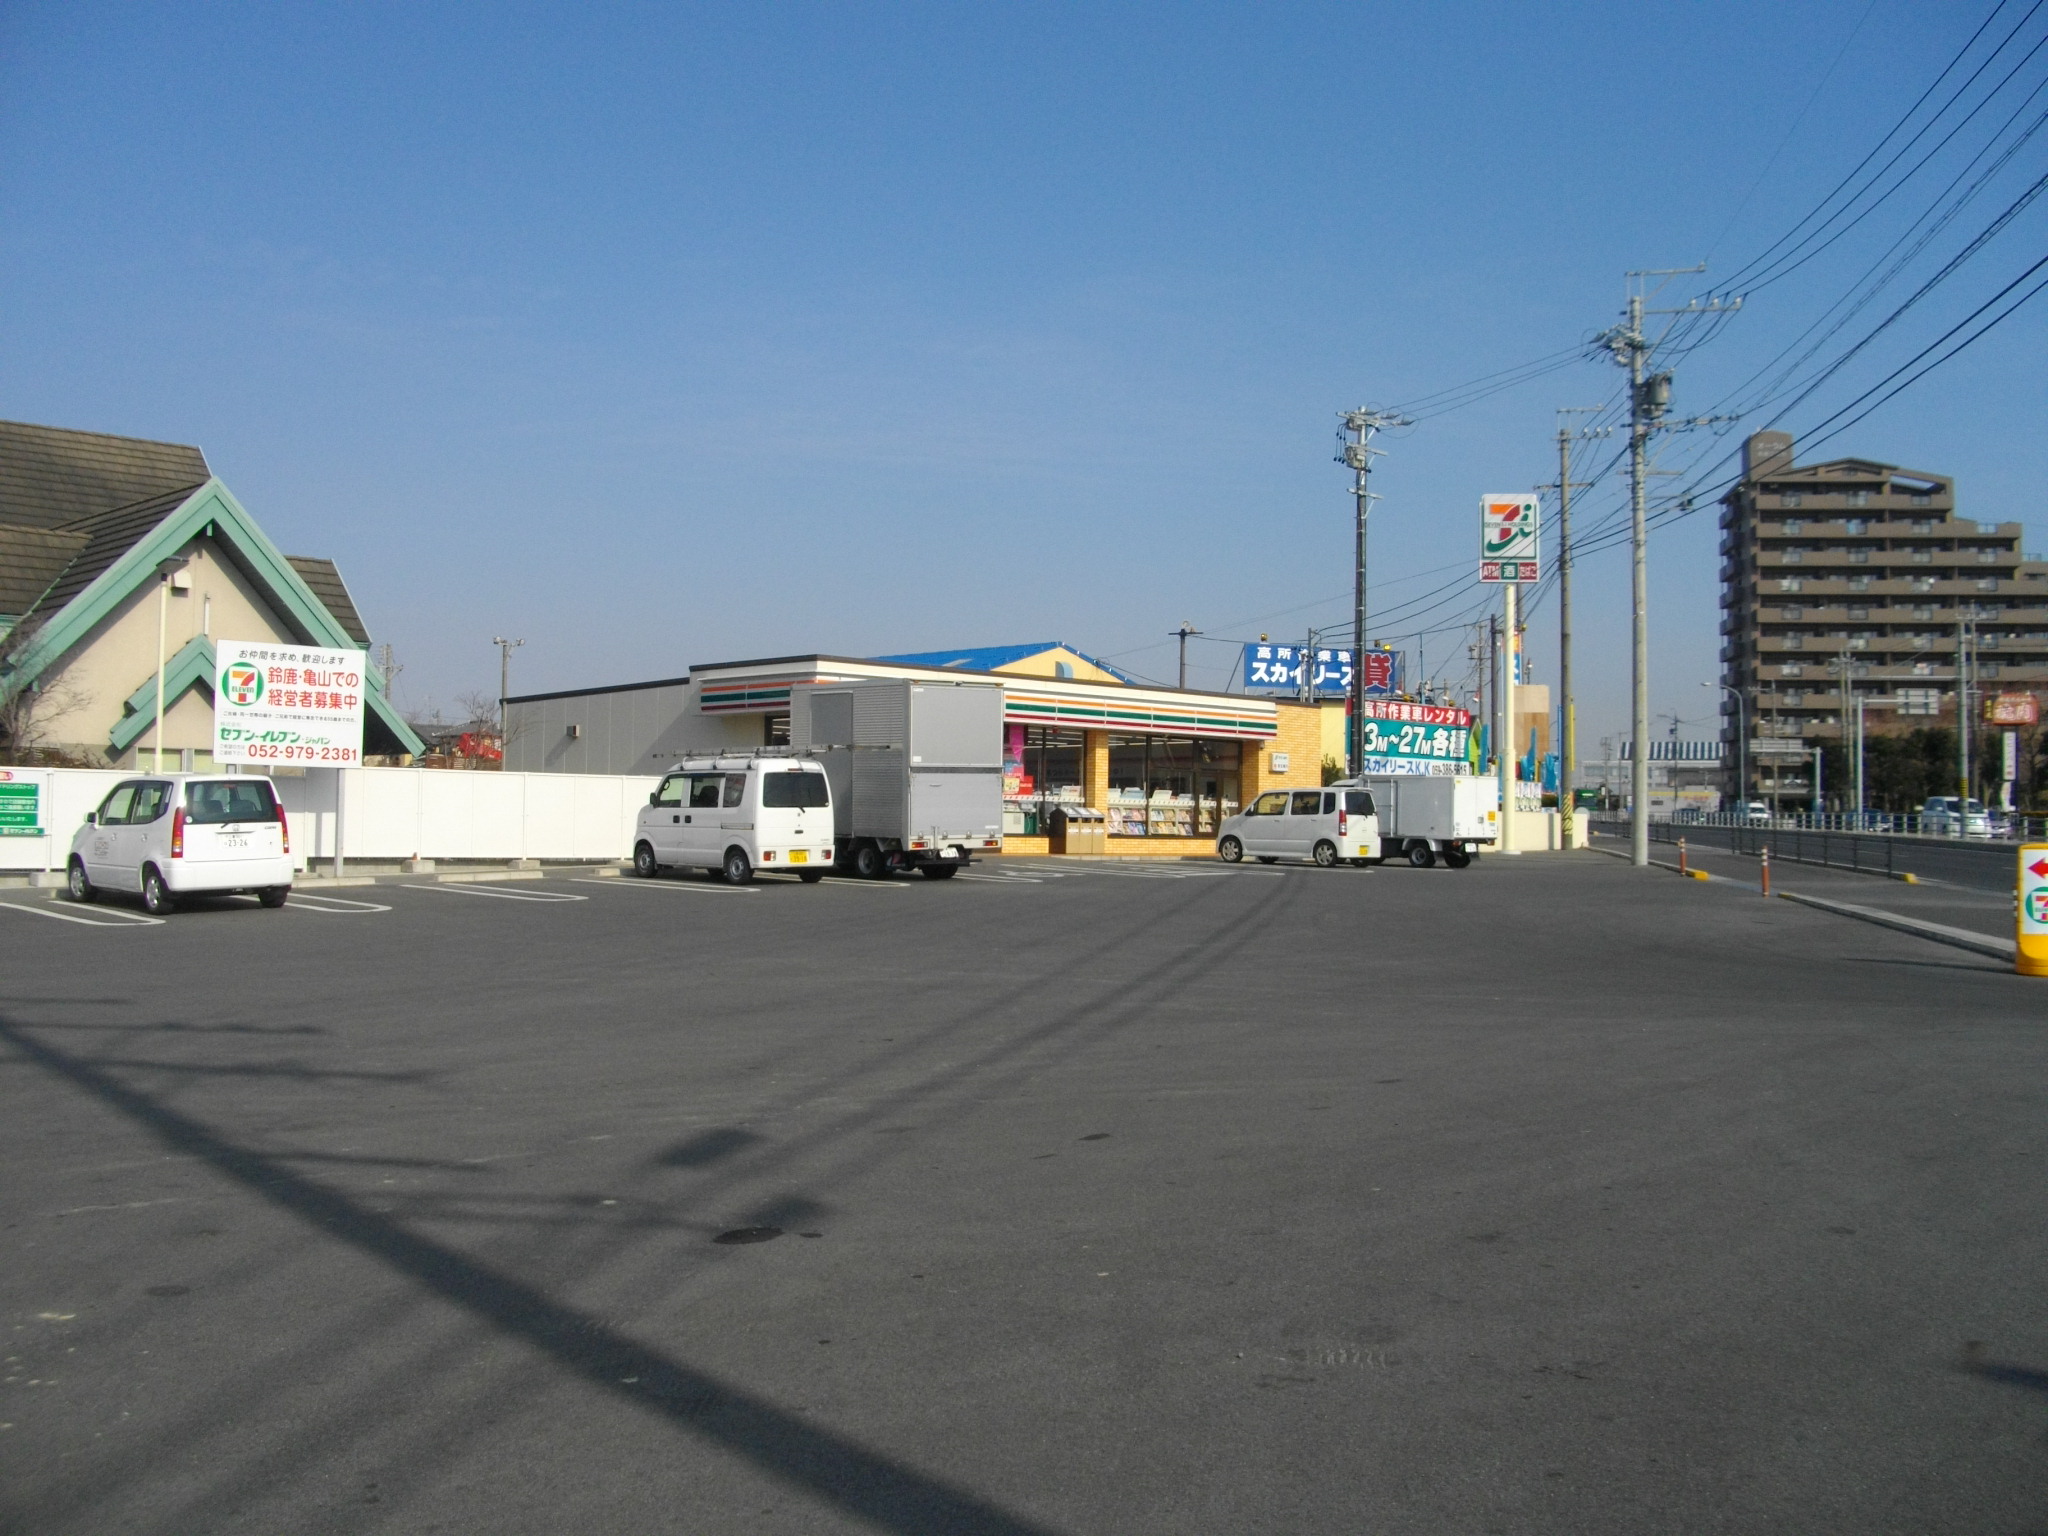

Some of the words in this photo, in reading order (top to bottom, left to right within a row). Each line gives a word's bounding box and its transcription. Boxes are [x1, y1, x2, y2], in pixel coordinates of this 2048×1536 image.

[1482, 565, 1499, 577] ATM
[267, 666, 359, 688] 鈴鹿・亀山での
[1251, 662, 1354, 686] スカイリース
[267, 688, 358, 710] 経営者募集中
[1364, 701, 1467, 725] 高所作業車レンタル
[248, 744, 358, 761] 052-979-2381
